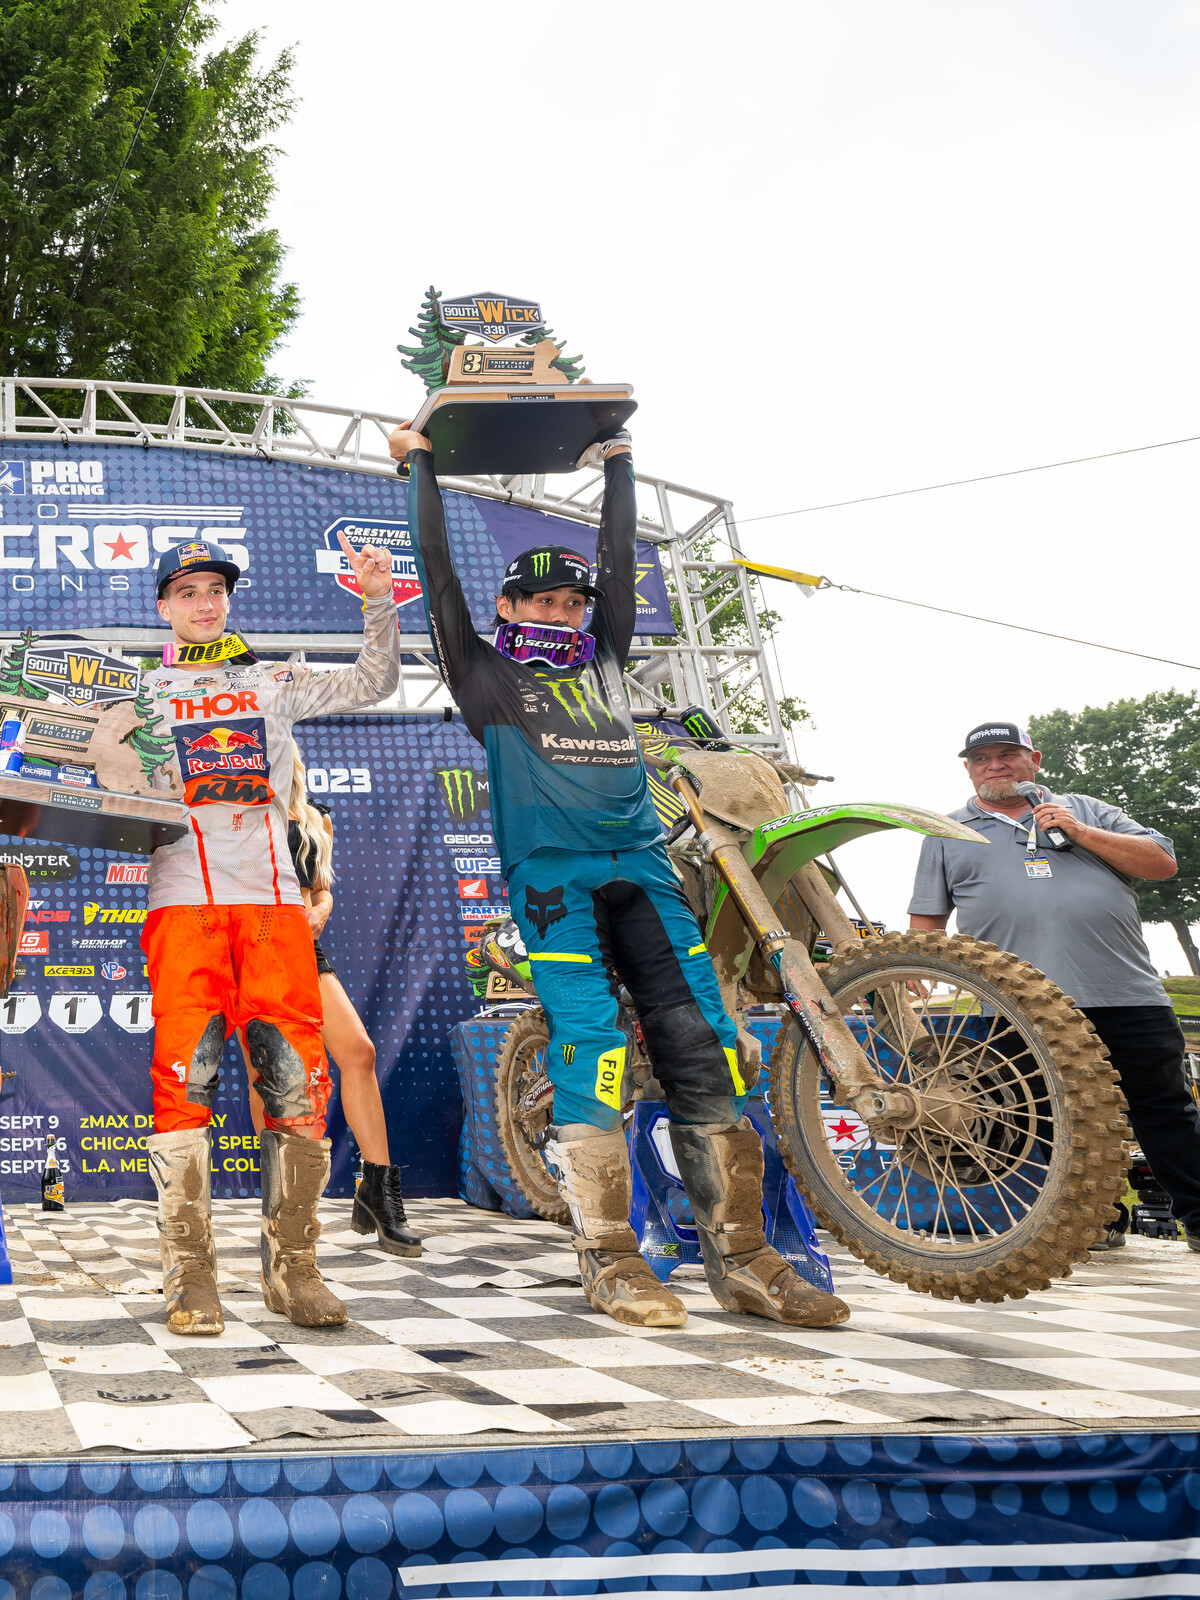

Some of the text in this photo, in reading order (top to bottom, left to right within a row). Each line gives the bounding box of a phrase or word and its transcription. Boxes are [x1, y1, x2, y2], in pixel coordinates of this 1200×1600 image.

[444, 301, 536, 322] SOUTH WICK
[483, 325, 506, 334] 338
[464, 353, 482, 372] 3
[31, 461, 103, 483] PRO
[31, 484, 105, 496] RACING
[346, 536, 412, 547] CONSTRUCTIO
[565, 560, 588, 573] Kawasaki
[178, 635, 243, 662] 100%
[523, 638, 575, 651] SCOTT
[28, 656, 134, 689] SOUTH WICK
[227, 670, 261, 679] AIROH
[67, 685, 93, 700] 338
[168, 689, 204, 698] MOTOREX
[169, 690, 261, 720] THOR
[36, 723, 87, 736] FIRST PLACE
[38, 728, 80, 741] 250 CLASS
[540, 733, 638, 752] Kawasaki
[187, 753, 266, 775] Red Bull
[551, 754, 638, 765] PRO CIRCUIT
[63, 774, 86, 783] SOUTHWICK
[304, 768, 372, 794] 023
[191, 777, 269, 803] KTM
[53, 798, 89, 807] SOUTHWICK,
[760, 815, 794, 834] PRO
[443, 834, 493, 845] GEICO
[461, 906, 510, 915] PARTS
[101, 962, 119, 979] VP
[494, 976, 507, 991] 2
[599, 1059, 618, 1095] FOX
[0, 1116, 44, 1130] SEPT
[48, 1115, 60, 1130] 9
[80, 1115, 129, 1129] zMAX
[0, 1137, 45, 1152] SEPT
[0, 1159, 45, 1174] SEPT
[56, 1160, 71, 1174] 3
[82, 1159, 116, 1173] L.A.
[781, 1254, 808, 1262] CROSS
